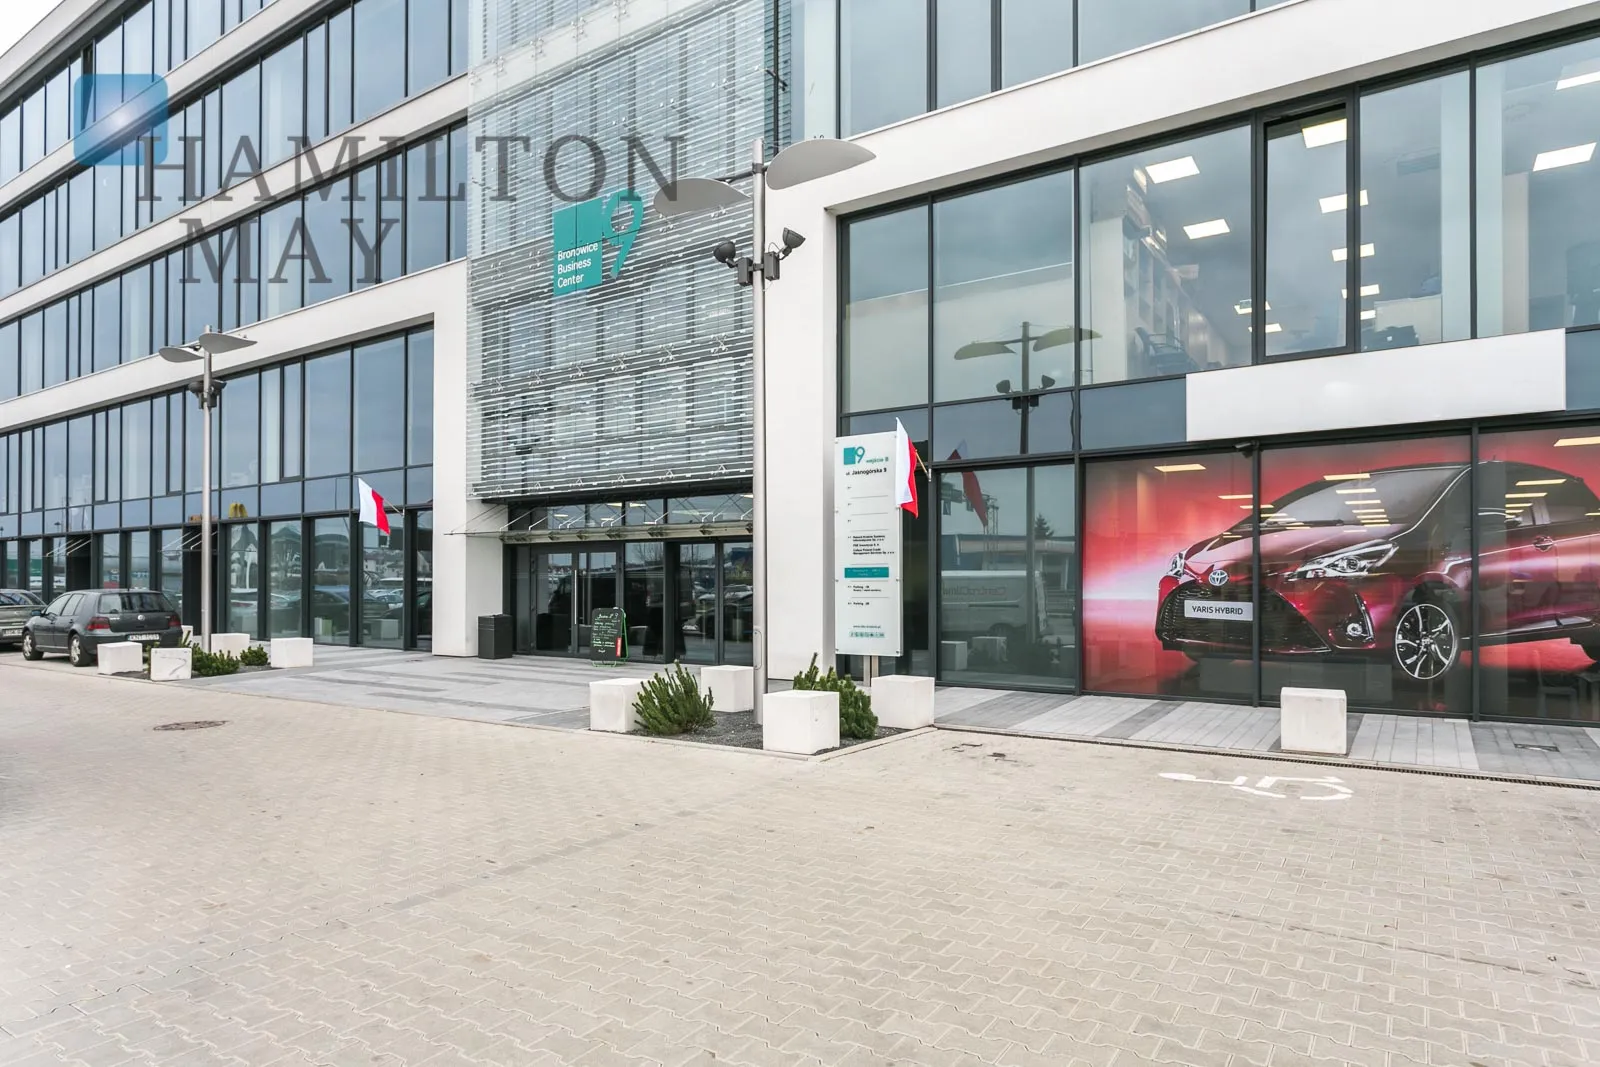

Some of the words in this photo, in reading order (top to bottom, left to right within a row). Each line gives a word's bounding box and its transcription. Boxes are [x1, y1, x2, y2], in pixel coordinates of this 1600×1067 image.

[602, 189, 643, 279] 9
[557, 242, 599, 261] Bronowice
[557, 258, 592, 274] Business
[557, 273, 585, 288] Center
[854, 446, 865, 463] 9
[1192, 605, 1214, 613] YARIS
[1215, 606, 1243, 615] HYBRID
